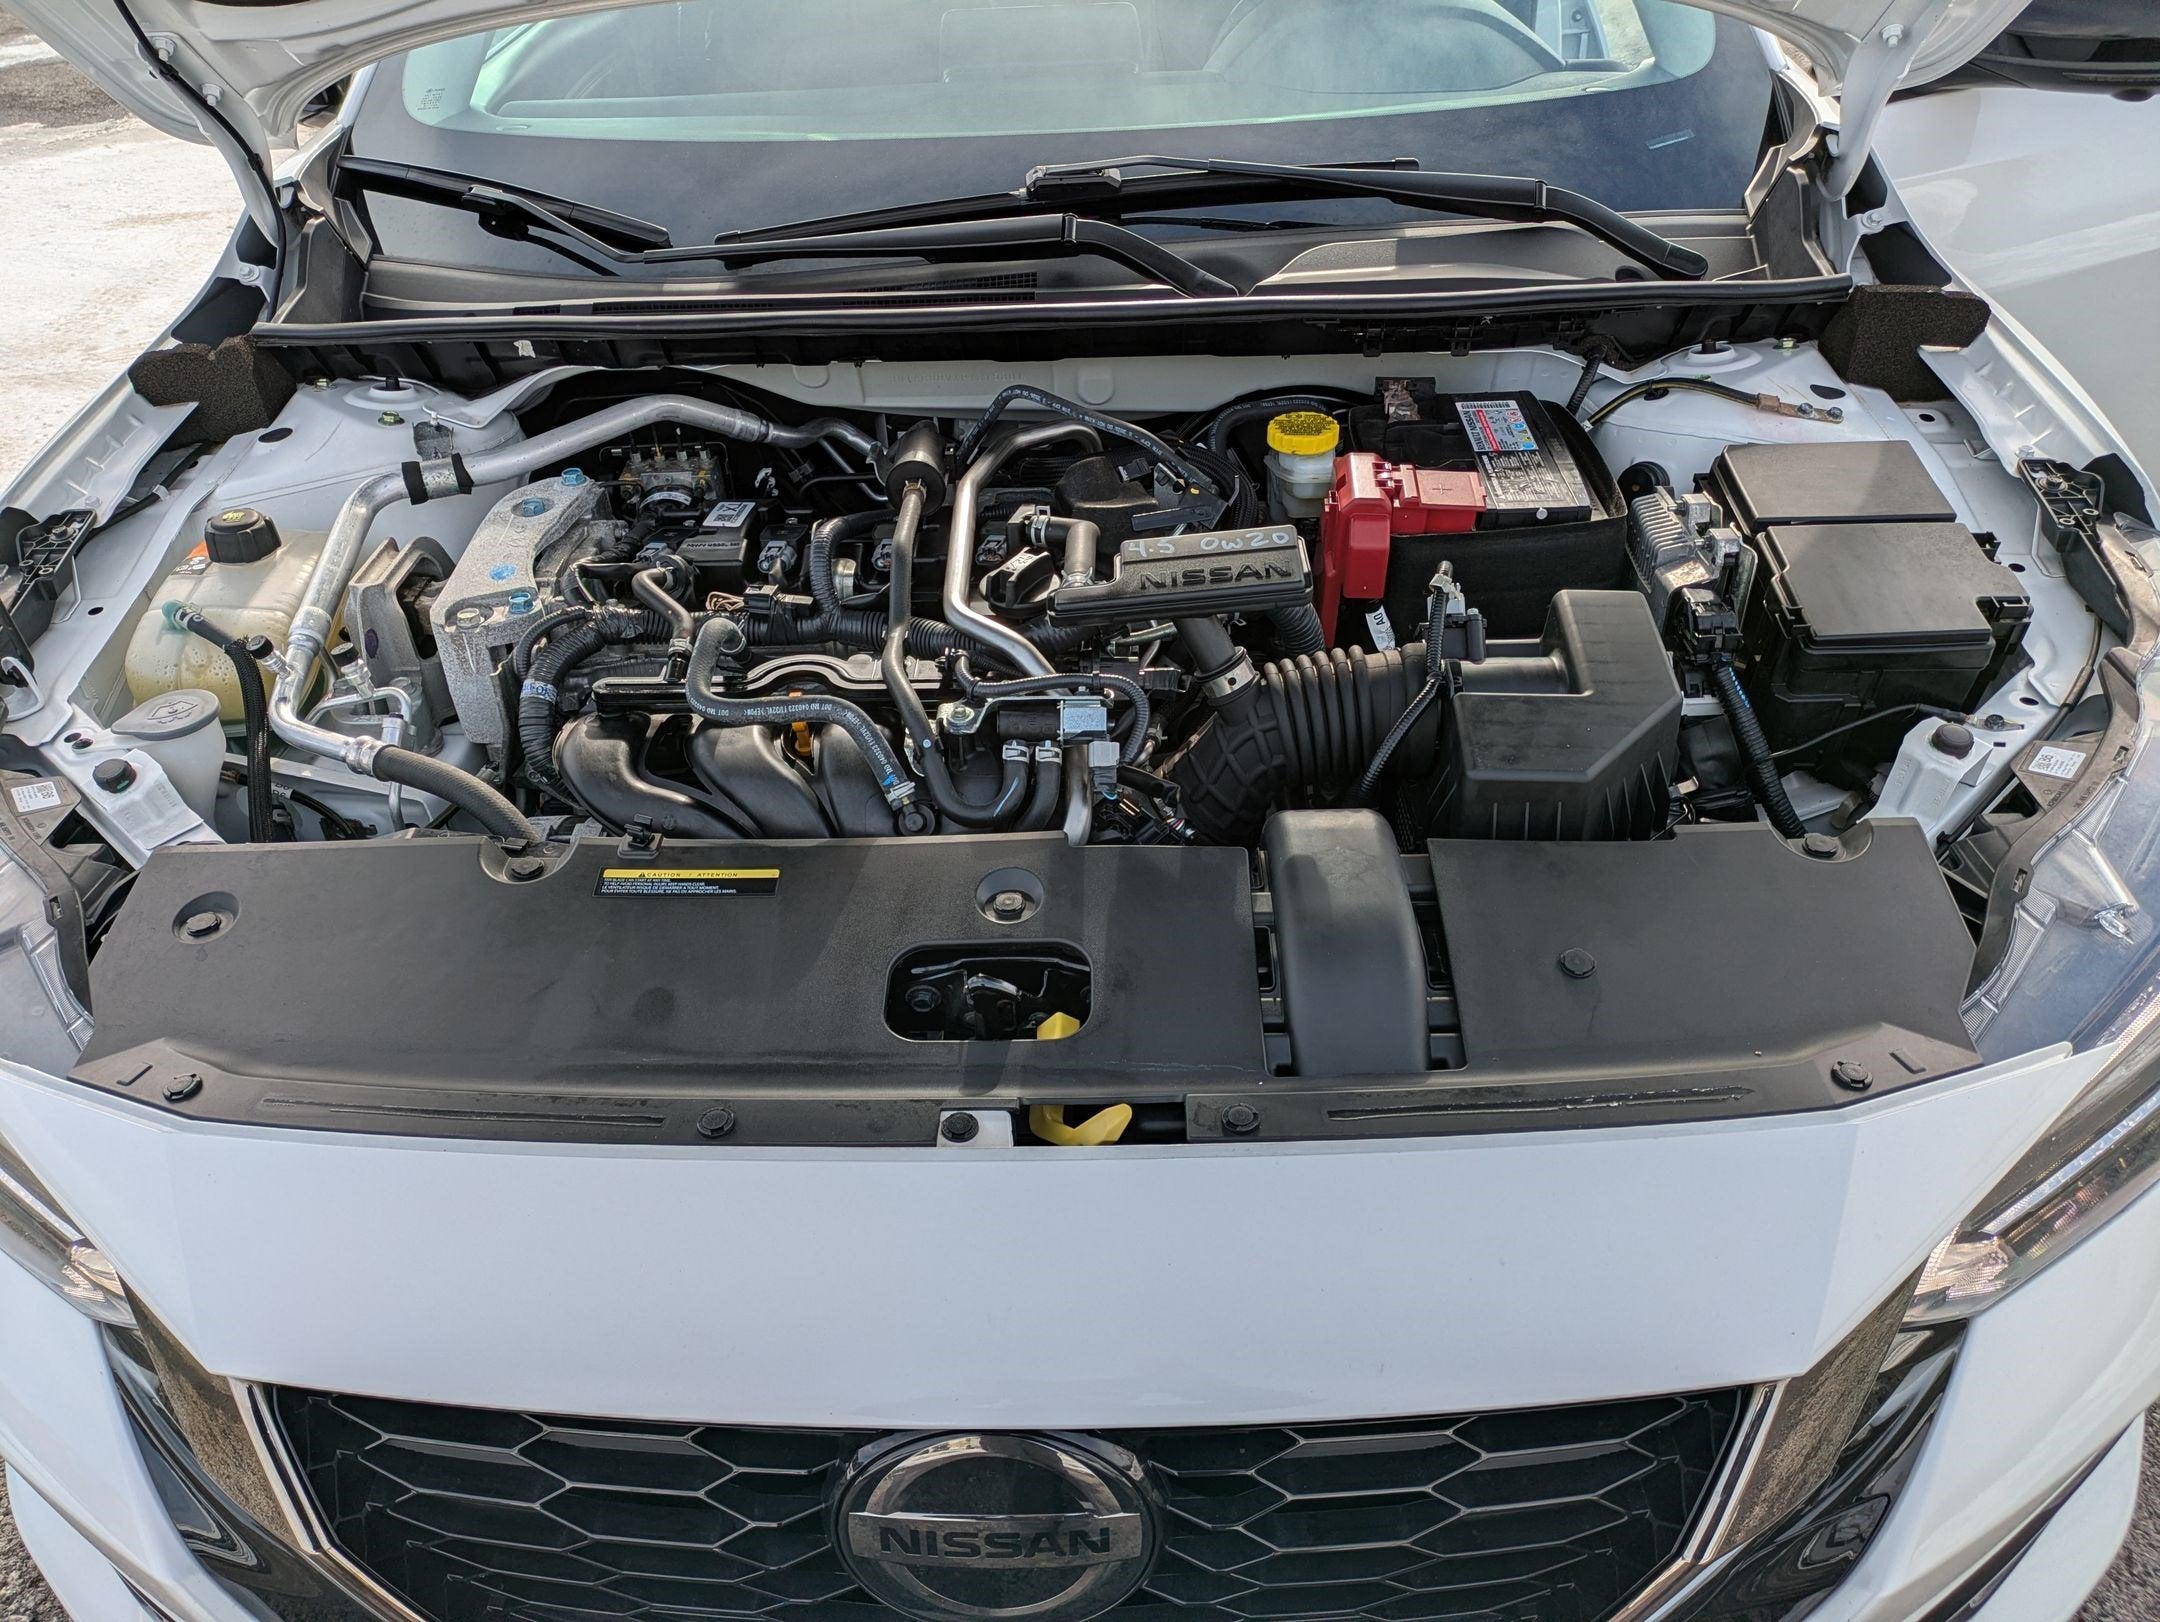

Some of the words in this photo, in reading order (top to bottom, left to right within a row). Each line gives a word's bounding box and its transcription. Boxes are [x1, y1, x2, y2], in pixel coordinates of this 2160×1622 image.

[1462, 410, 1478, 430] NISSAN
[1127, 540, 1175, 557] 4.5
[1140, 562, 1292, 591] NISSAN
[879, 1526, 1110, 1558] NISSAN
